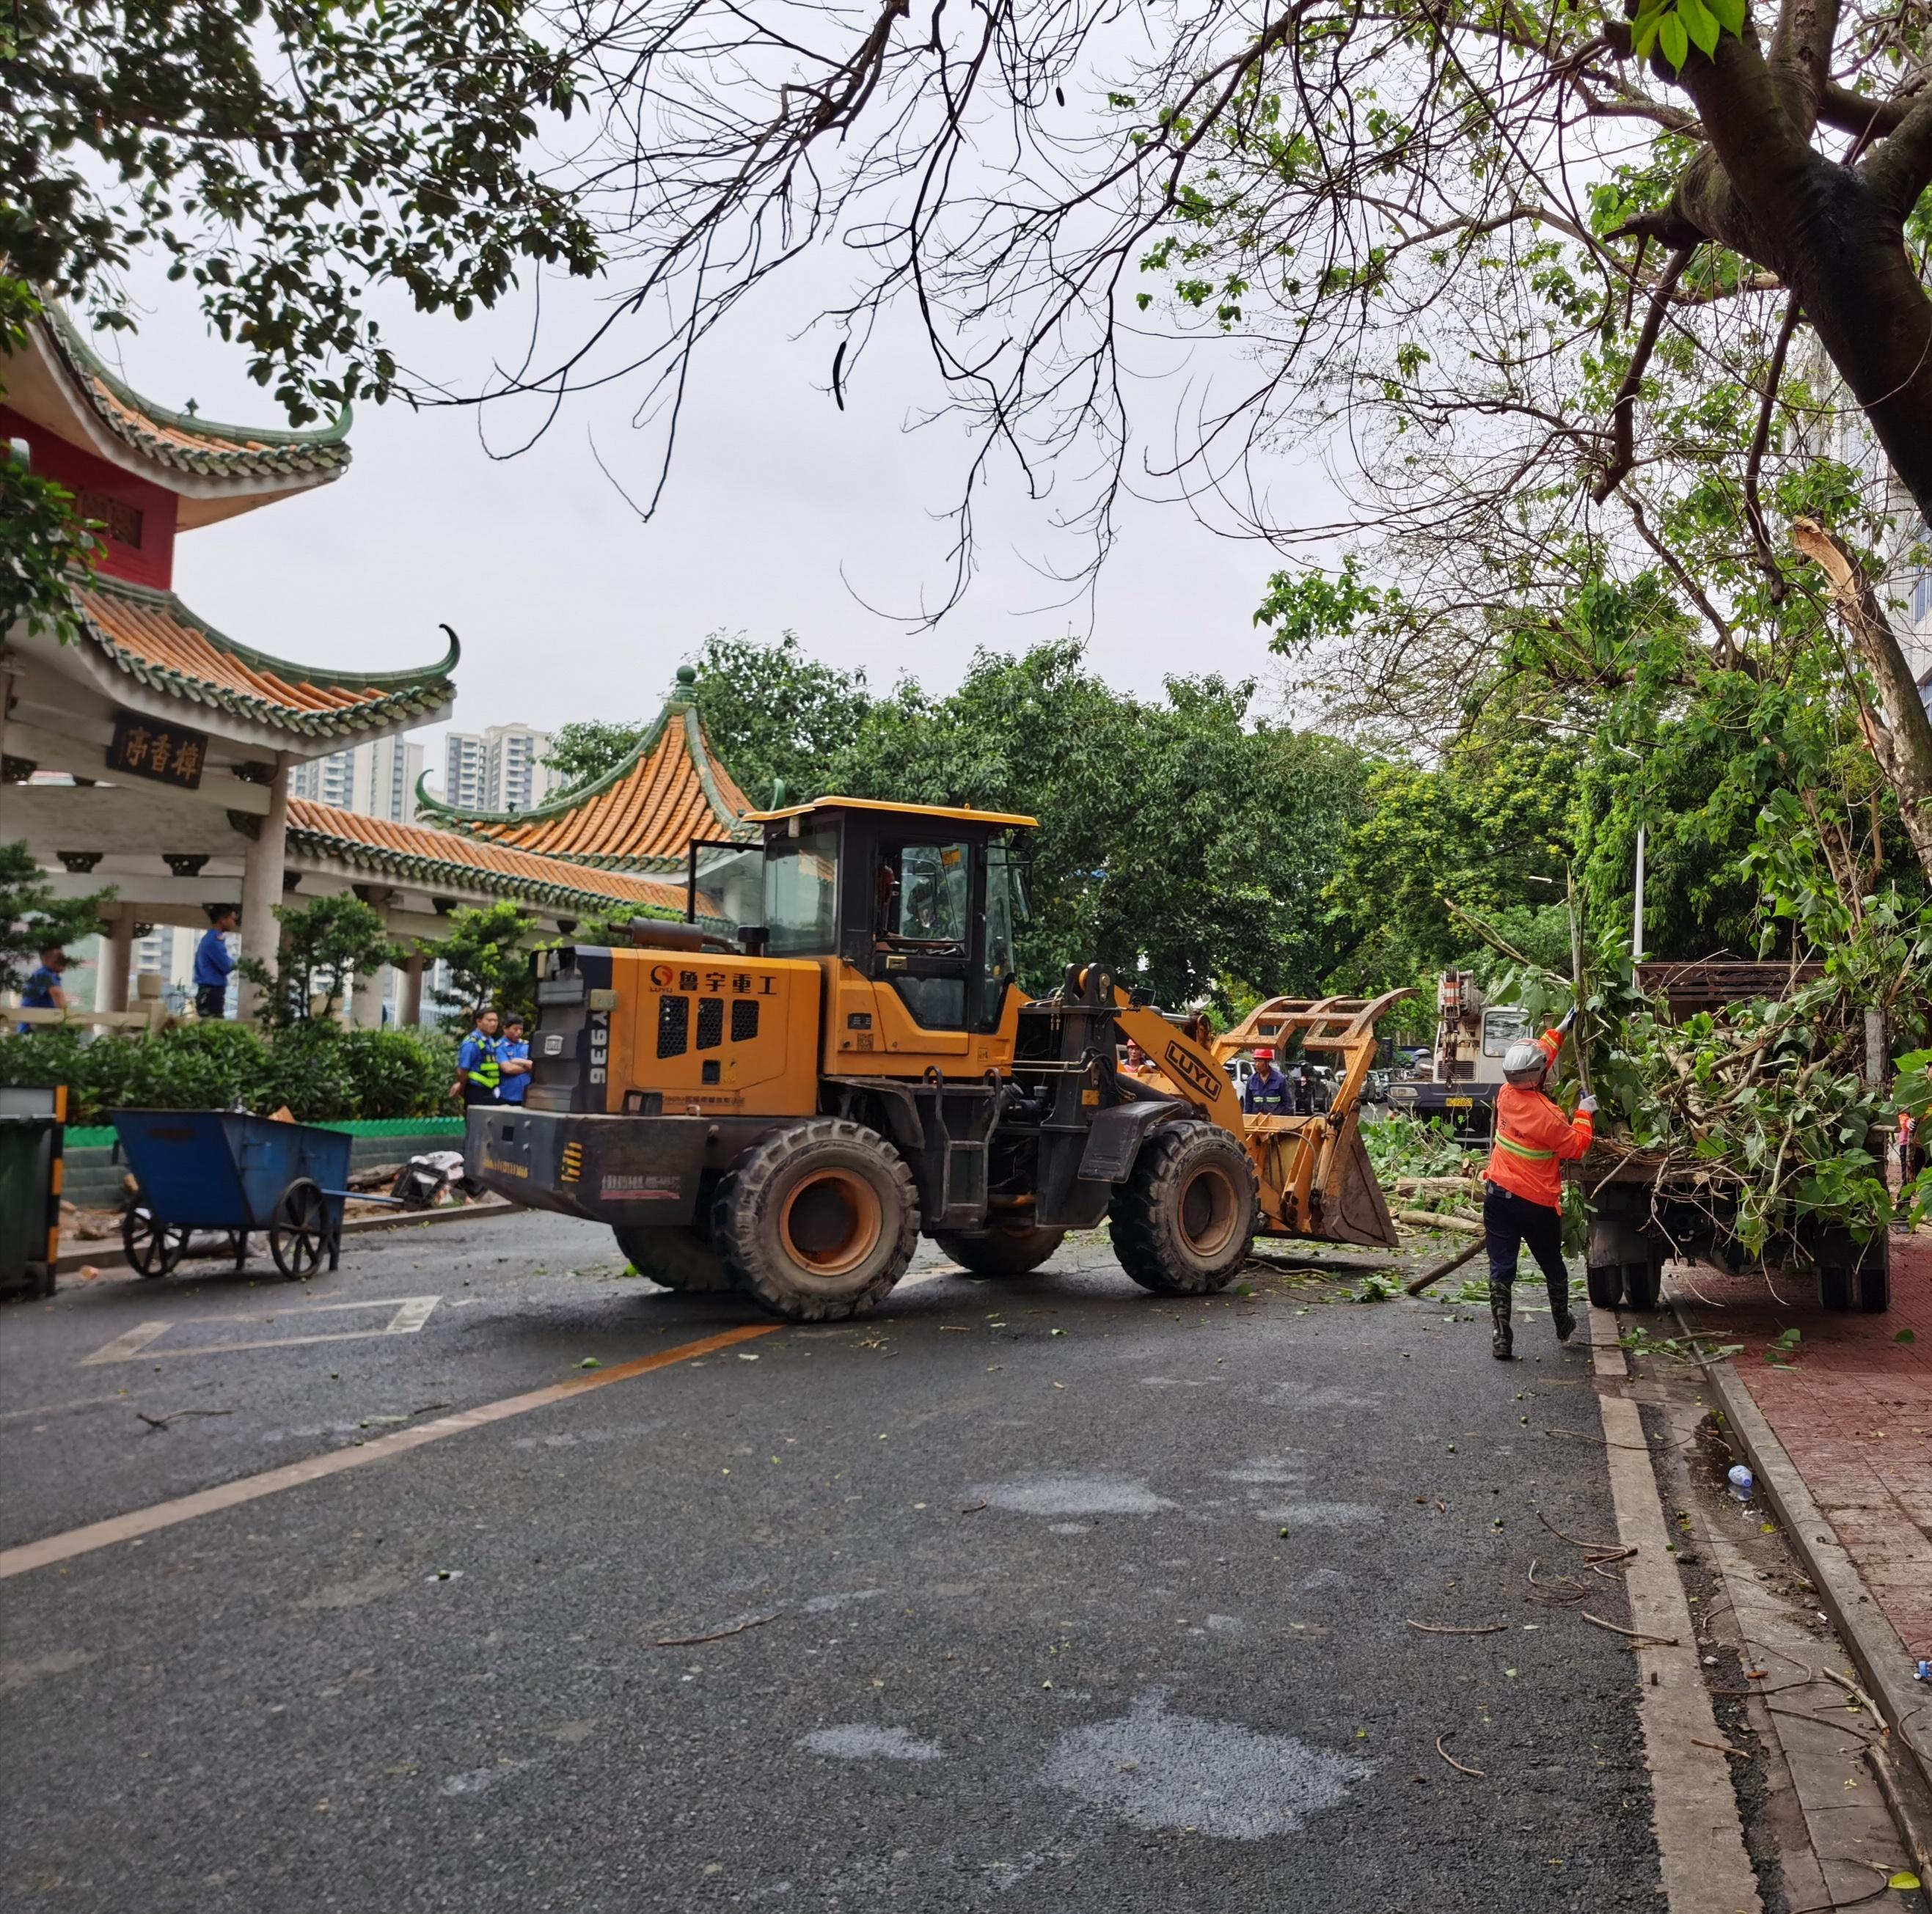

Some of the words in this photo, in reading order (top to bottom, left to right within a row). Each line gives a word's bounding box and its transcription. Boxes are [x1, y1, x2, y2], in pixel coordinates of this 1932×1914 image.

[679, 970, 777, 995] 鲁宇重工
[1168, 1045, 1219, 1097] LUYU
